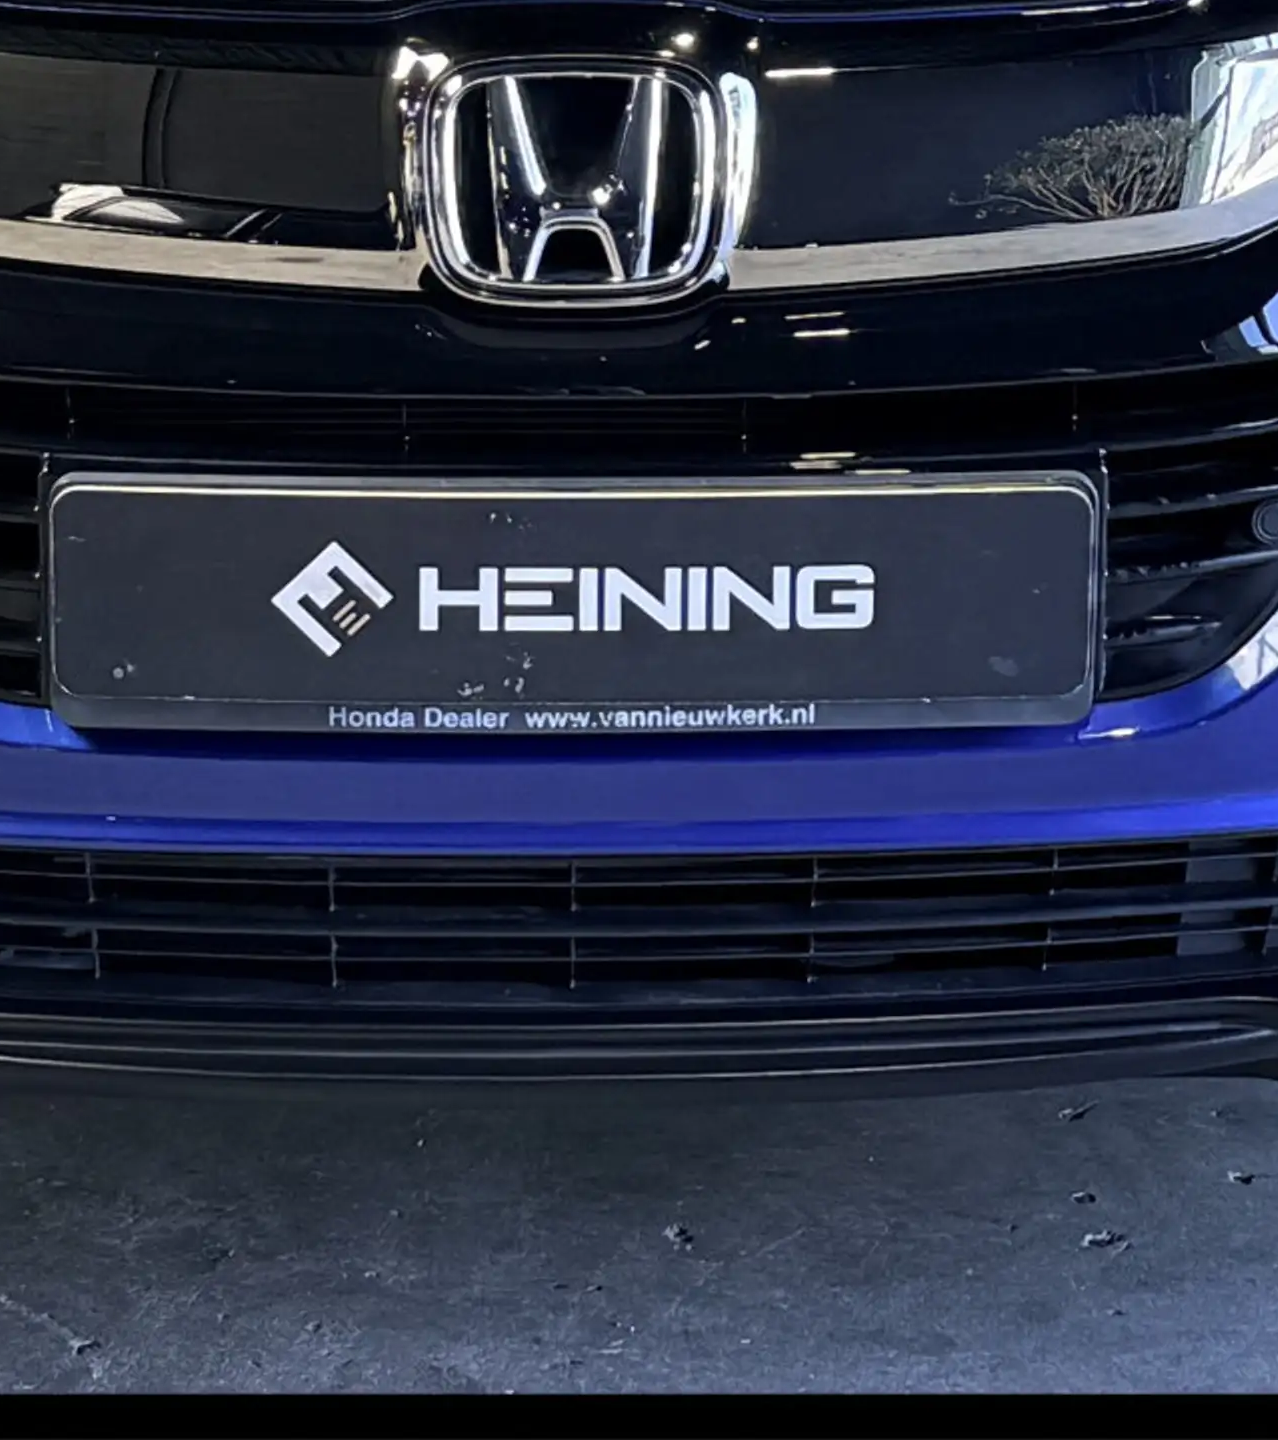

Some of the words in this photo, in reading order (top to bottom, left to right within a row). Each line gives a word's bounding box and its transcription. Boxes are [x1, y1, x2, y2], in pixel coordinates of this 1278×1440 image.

[417, 563, 876, 633] HEINING
[327, 705, 416, 729] Honda
[424, 706, 511, 729] Dealer
[524, 702, 816, 729] www.vannieuwkerk.nl
